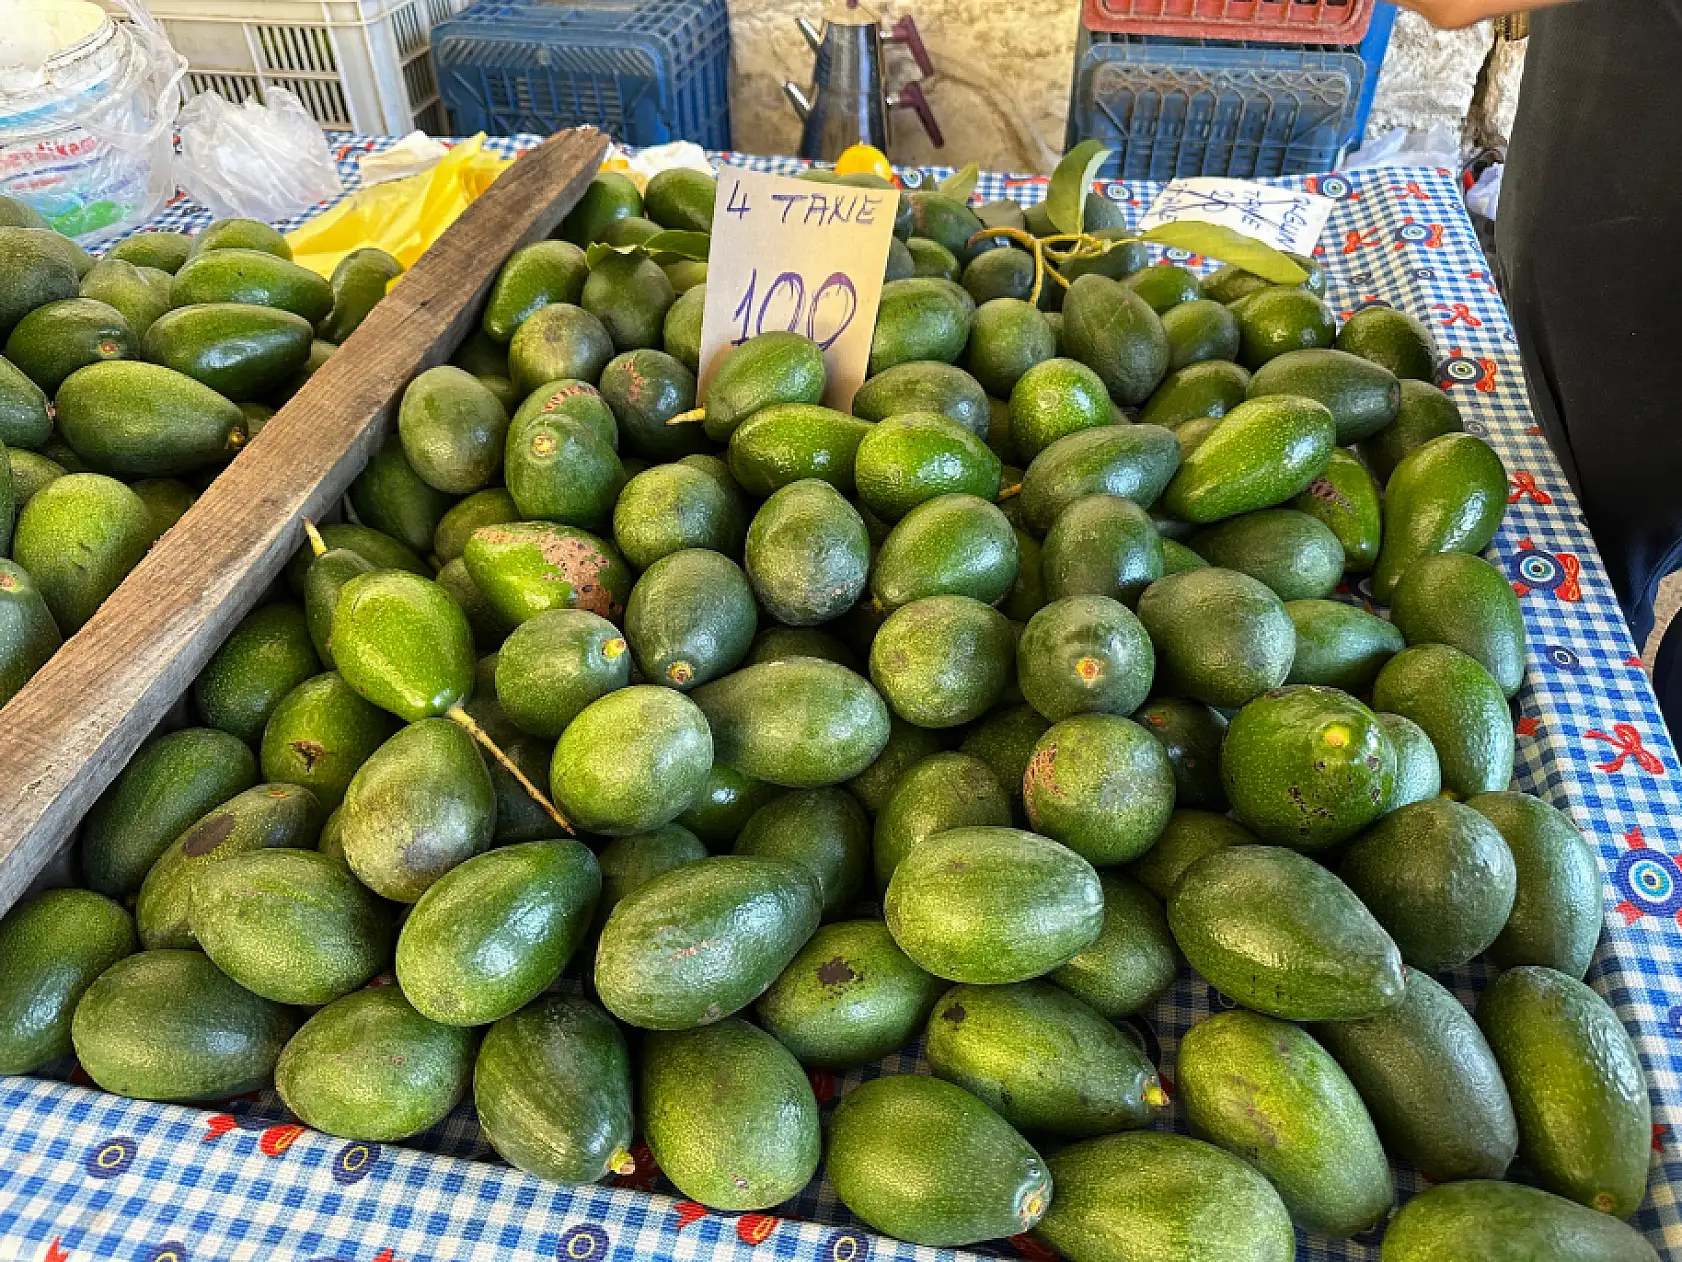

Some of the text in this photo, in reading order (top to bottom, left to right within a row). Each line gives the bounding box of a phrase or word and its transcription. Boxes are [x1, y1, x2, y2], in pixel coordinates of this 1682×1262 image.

[726, 179, 882, 226] 4 TANE
[731, 268, 857, 351] 100
